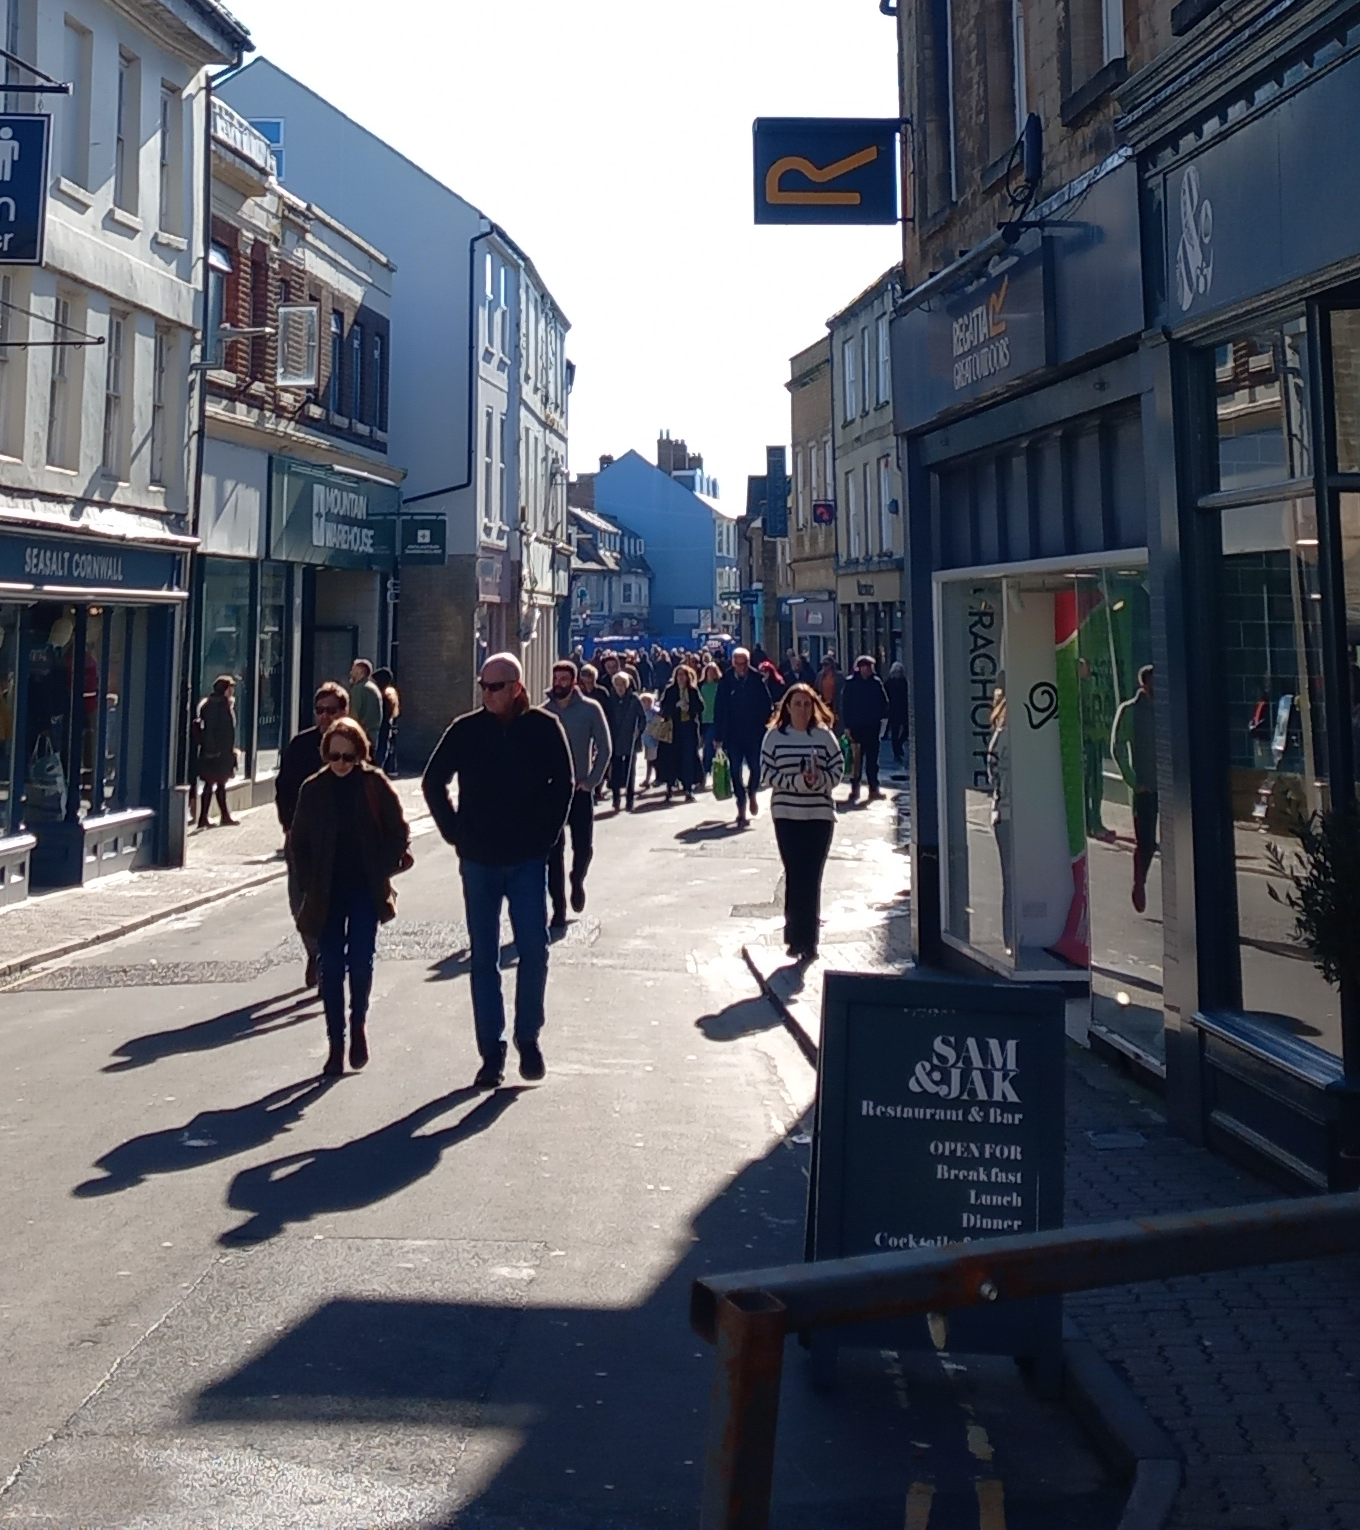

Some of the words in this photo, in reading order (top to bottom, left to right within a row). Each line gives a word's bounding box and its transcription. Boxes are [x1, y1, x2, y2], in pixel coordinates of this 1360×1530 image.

[952, 304, 989, 357] REGATTA
[325, 487, 367, 520] MOUNTAIN
[325, 522, 375, 554] WAREHOUSE
[24, 547, 70, 577] SEASALT
[72, 553, 123, 581] CORNWALL
[932, 1035, 1020, 1071] SAM
[861, 1099, 964, 1122] Restaurant
[967, 1106, 985, 1123] &
[989, 1107, 1023, 1125] Bar
[929, 1140, 980, 1158] OPEN
[984, 1143, 1022, 1161] FOR
[936, 1164, 1022, 1184] Breakfast
[969, 1189, 1022, 1208] Lunch
[962, 1212, 1022, 1231] Dinner
